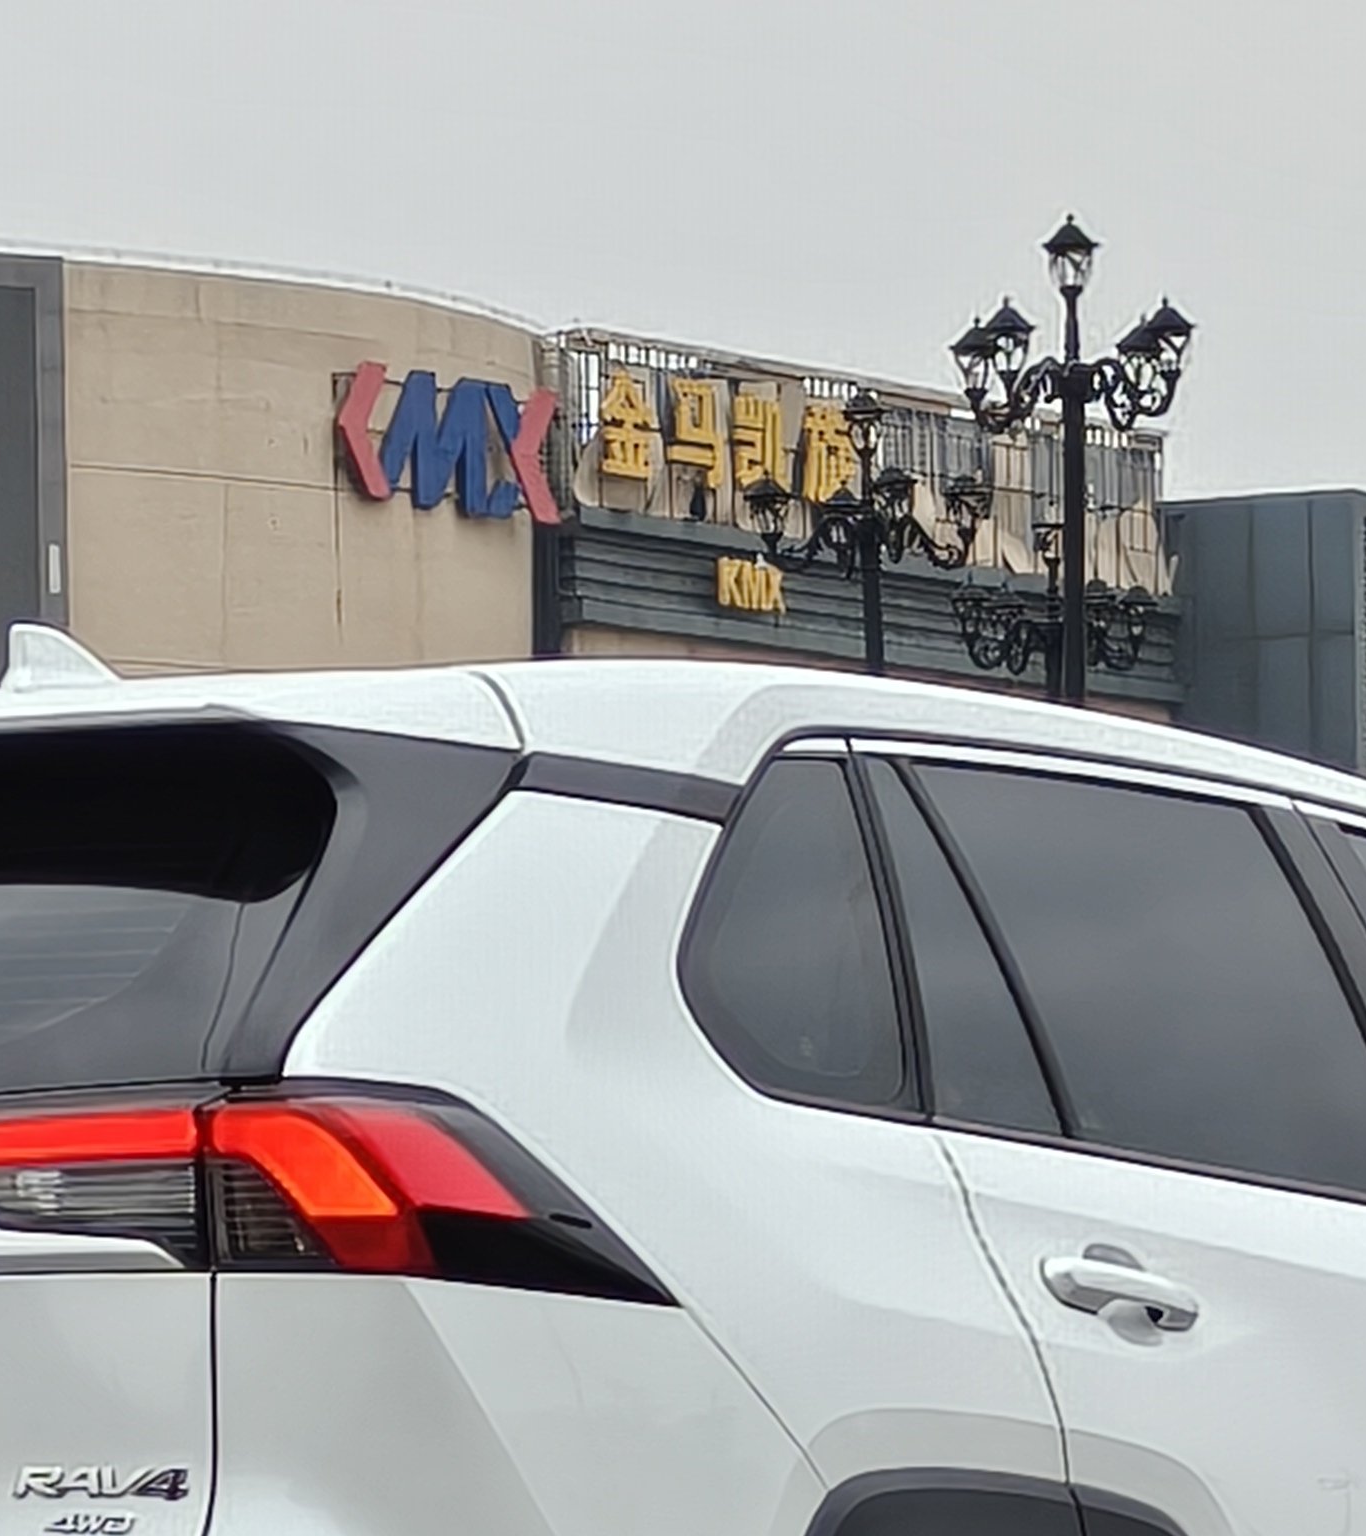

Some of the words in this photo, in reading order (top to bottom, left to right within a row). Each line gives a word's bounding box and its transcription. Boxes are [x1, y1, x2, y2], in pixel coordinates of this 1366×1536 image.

[717, 557, 784, 614] KMX
[14, 1466, 190, 1501] RAV4
[44, 1511, 137, 1536] 4WD
